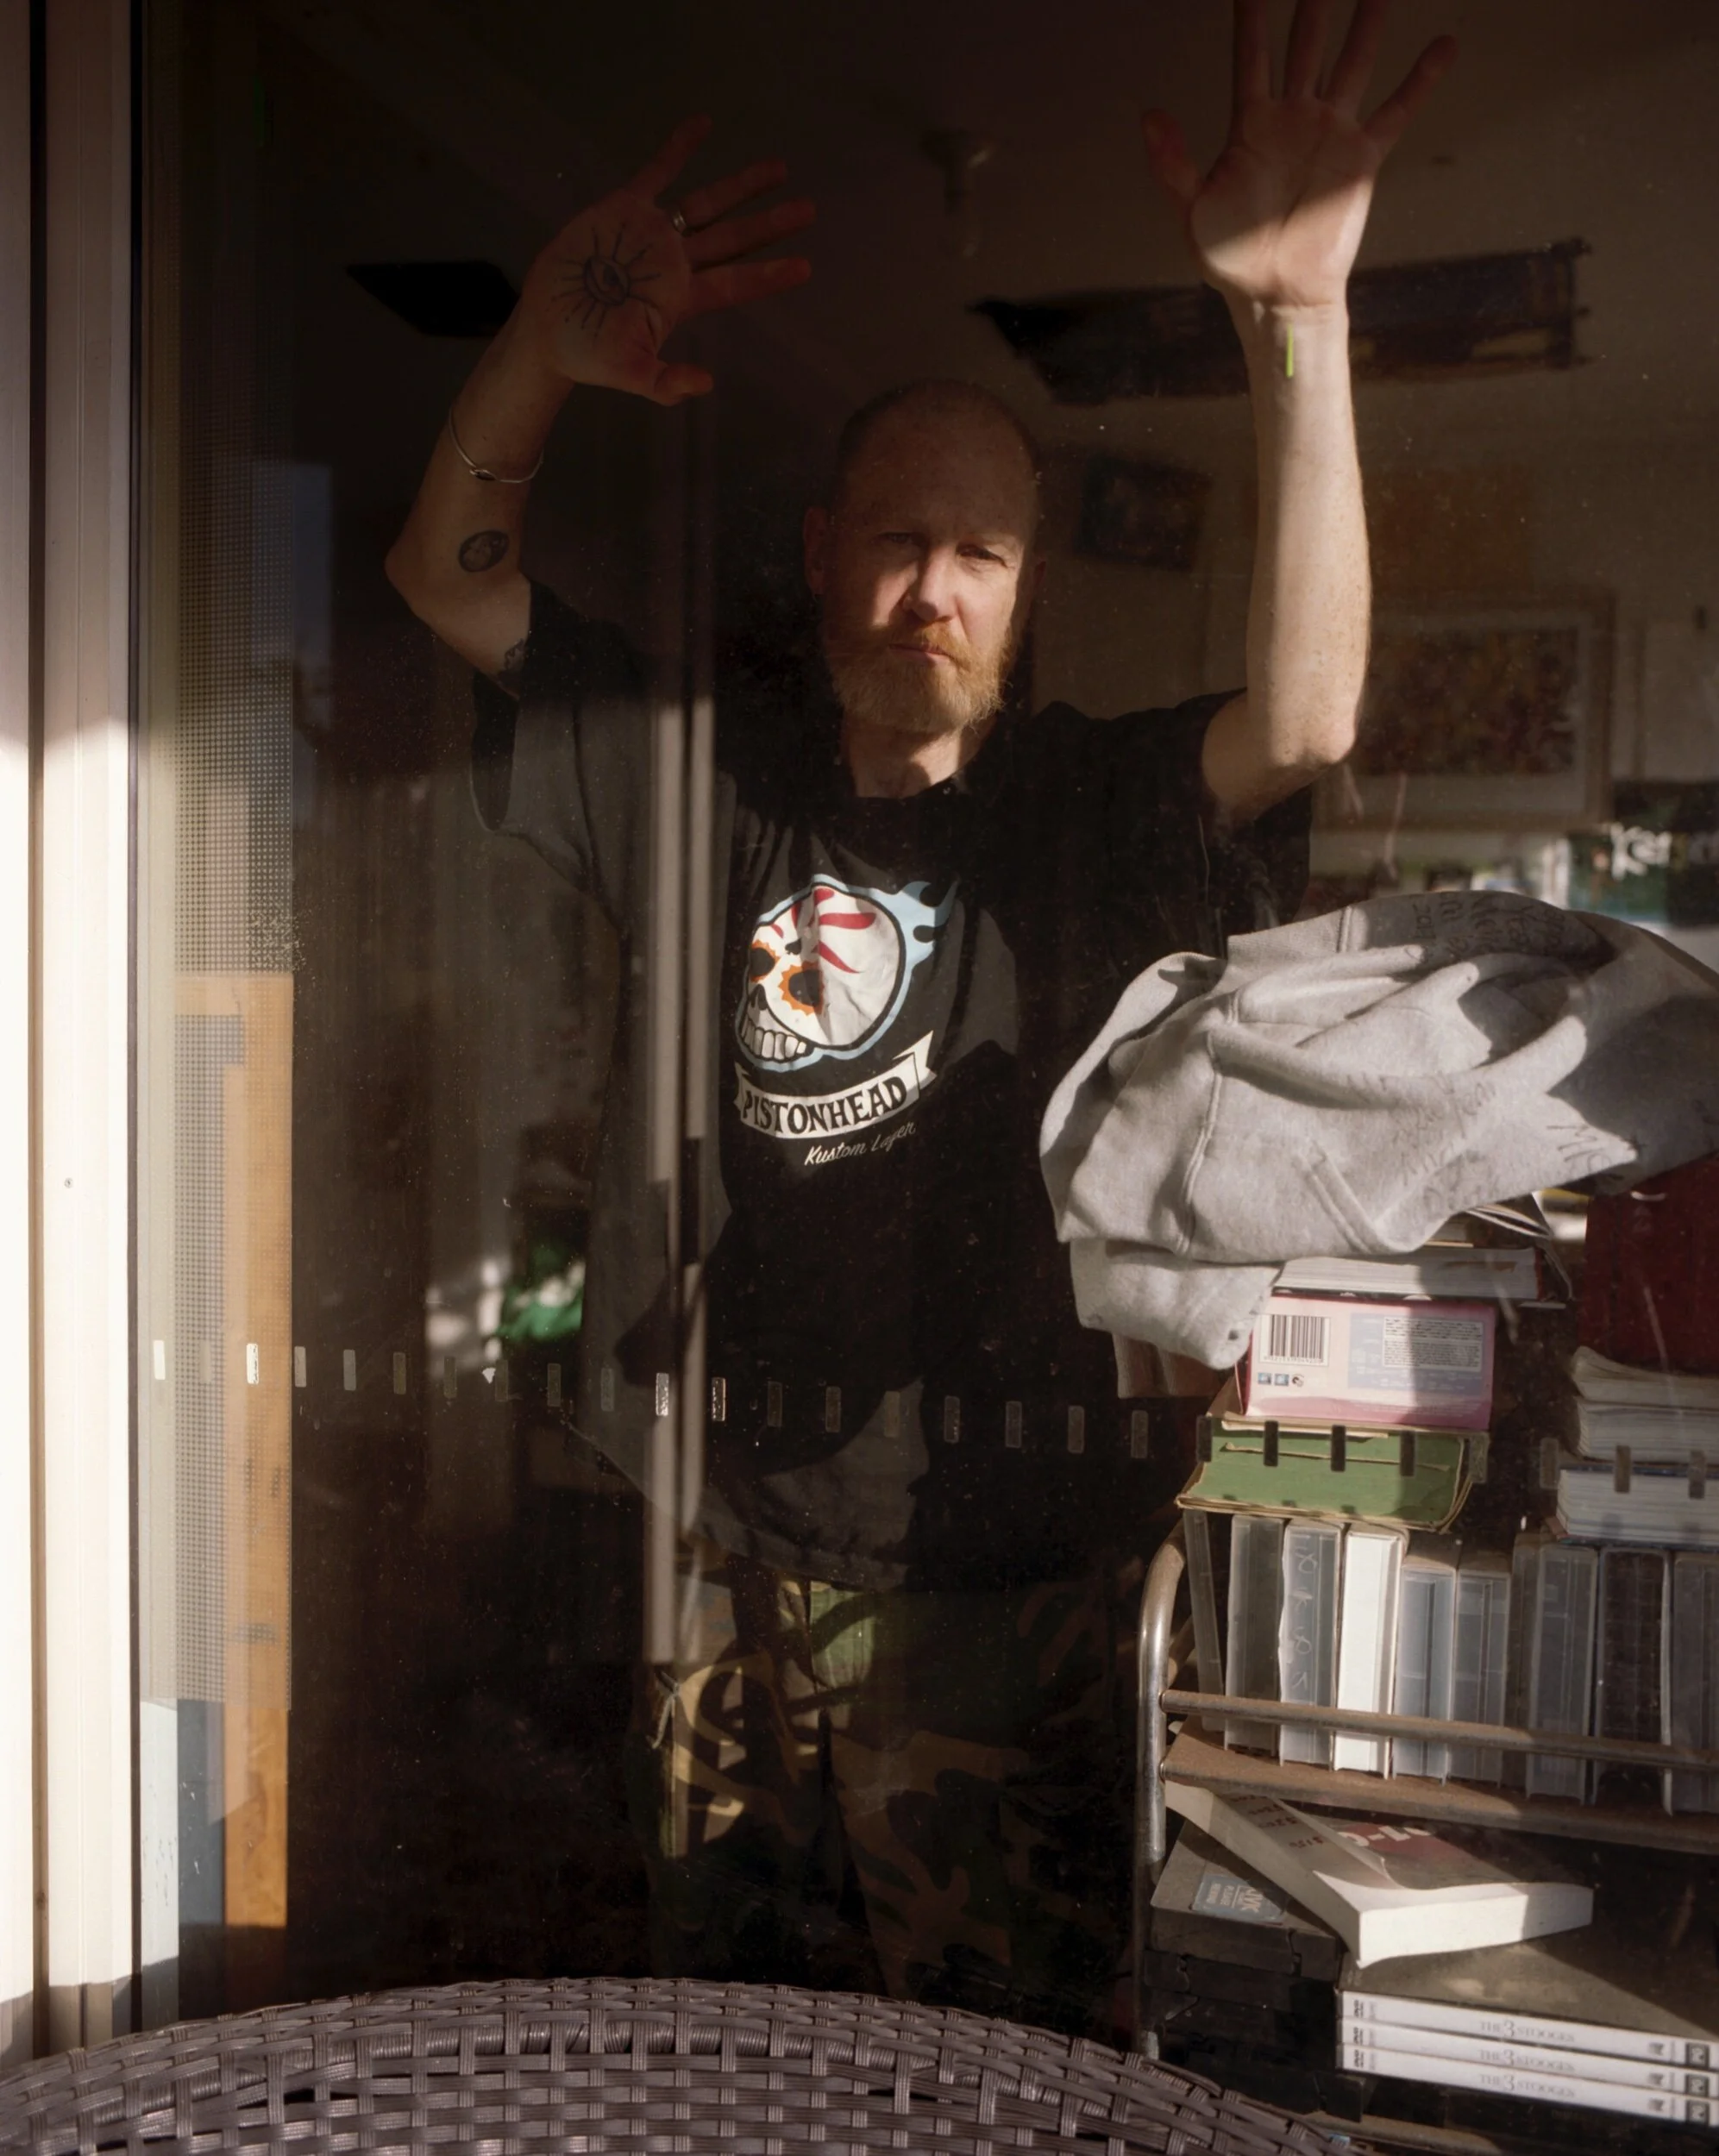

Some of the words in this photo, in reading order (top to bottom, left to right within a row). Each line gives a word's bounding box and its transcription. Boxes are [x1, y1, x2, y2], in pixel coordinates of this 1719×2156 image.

[739, 1075, 907, 1135] PISTONHEAD
[804, 1140, 867, 1166] Kustom
[869, 1121, 916, 1153] Lager
[1503, 2018, 1515, 2038] 3
[1503, 2048, 1515, 2067] 3
[1503, 2073, 1515, 2091] 3
